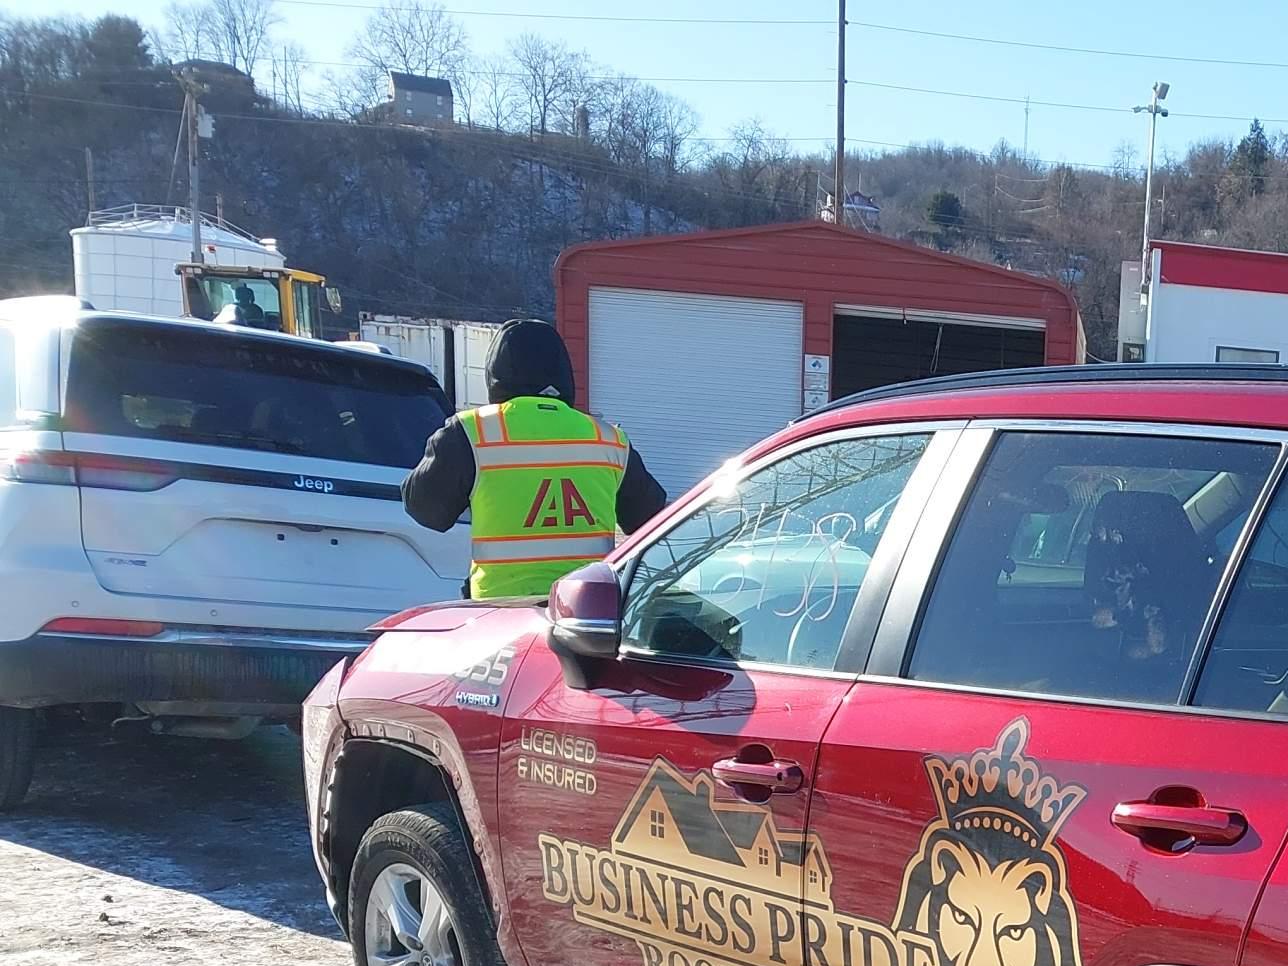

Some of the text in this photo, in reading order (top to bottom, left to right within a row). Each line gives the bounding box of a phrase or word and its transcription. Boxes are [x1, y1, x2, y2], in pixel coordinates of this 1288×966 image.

[294, 475, 334, 493] Jeep
[456, 691, 491, 706] HYBRID
[521, 726, 597, 765] LICENSED
[517, 759, 597, 795] & INSURED
[540, 840, 758, 954] BUSINESS
